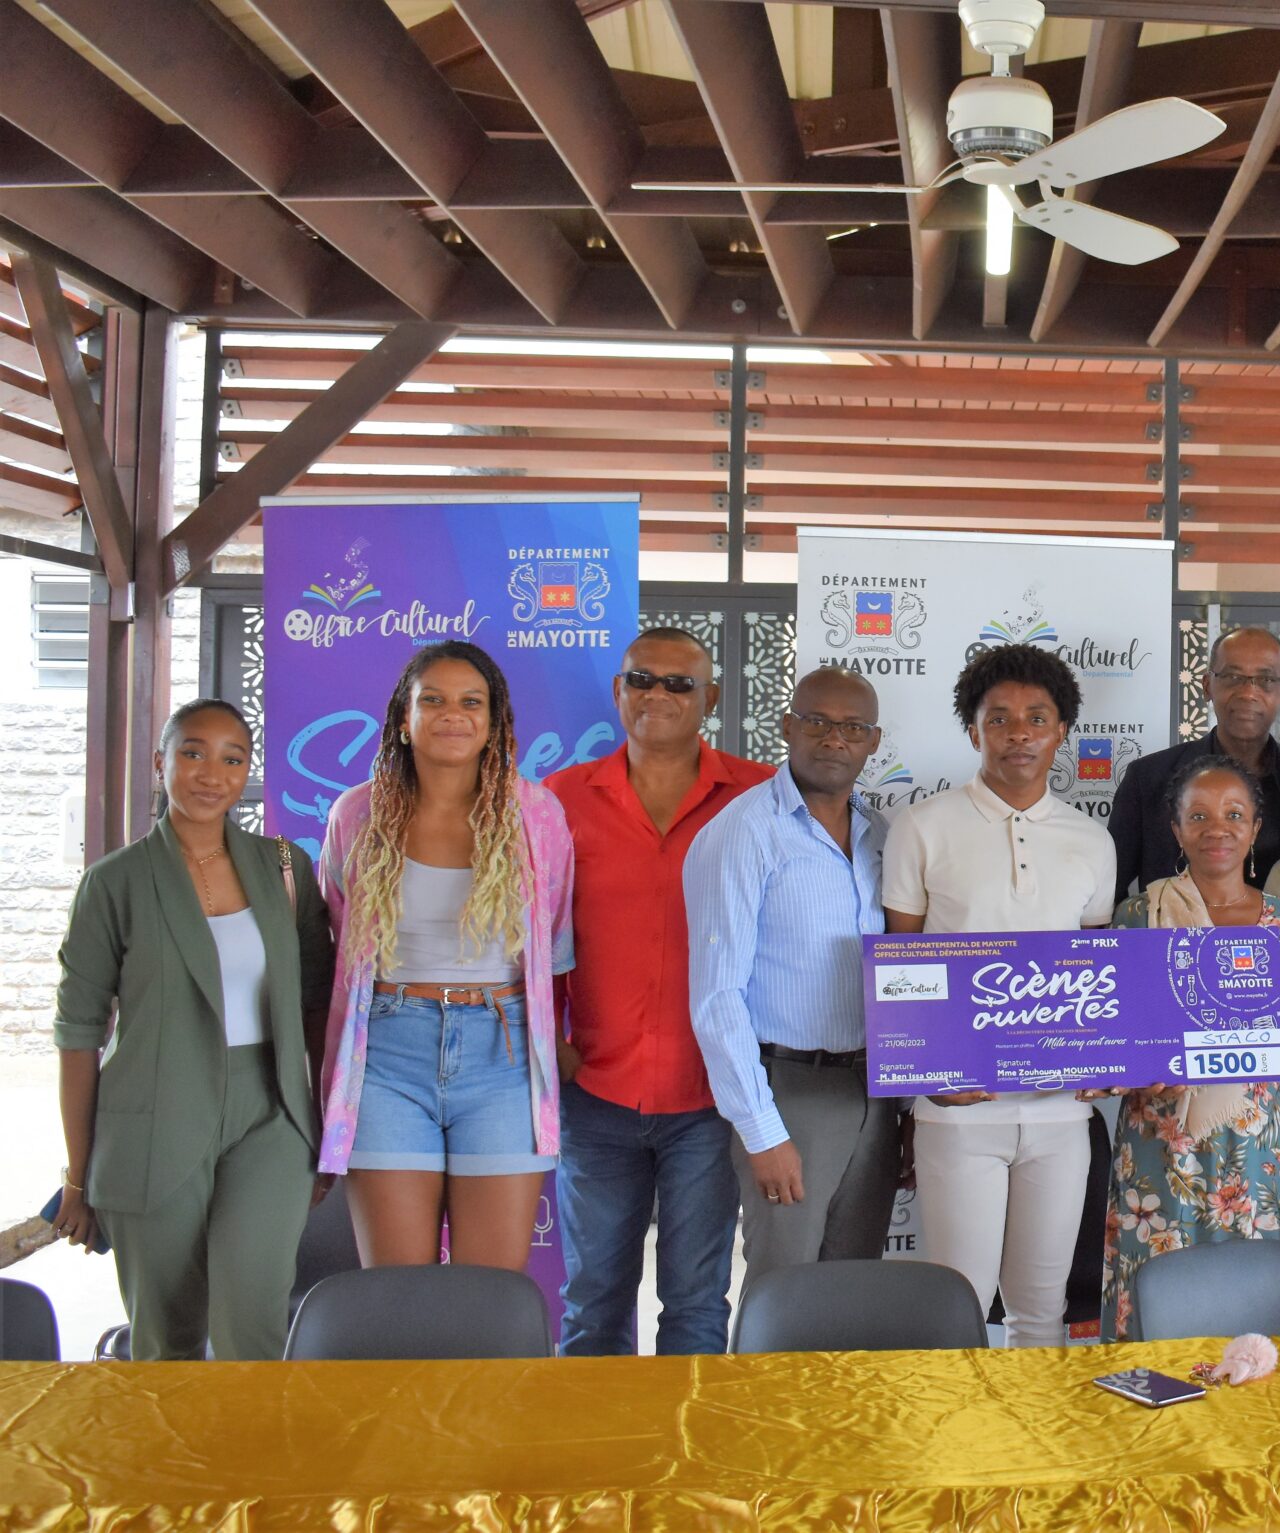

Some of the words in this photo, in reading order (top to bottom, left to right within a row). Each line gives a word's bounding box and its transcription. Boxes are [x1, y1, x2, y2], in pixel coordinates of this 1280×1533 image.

[508, 546, 610, 560] DÉPARTEMENT
[821, 573, 927, 589] DÉPARTEMENT
[284, 608, 367, 648] Office
[380, 599, 491, 638] Culturel
[507, 630, 517, 648] DE
[518, 629, 611, 648] MAYOTTE
[1073, 723, 1145, 734] ARTEMENT
[874, 942, 906, 950] CONSEIL
[907, 940, 970, 949] DÉPARTEMENTAL
[1071, 938, 1090, 949] 2ème
[1093, 938, 1119, 948] PRIX
[939, 948, 1002, 957] DÉPARTEMENTAL
[1063, 958, 1094, 966] ÉDITION
[971, 960, 1117, 1007] Scènes
[1225, 978, 1273, 988] MAYOTTE
[972, 994, 1120, 1031] ouvertes
[885, 1039, 926, 1048] 21/06/2023
[1037, 1036, 1065, 1050] Mille
[1201, 1031, 1271, 1045] STACO
[879, 1063, 915, 1072] Signature
[996, 1059, 1031, 1068] Signature
[1193, 1051, 1257, 1075] 1500
[908, 1072, 924, 1080] Issa
[926, 1071, 963, 1079] OUSSENI
[997, 1069, 1017, 1077] Mme
[1063, 1066, 1107, 1075] MOUAYAD
[1109, 1065, 1126, 1073] BEN
